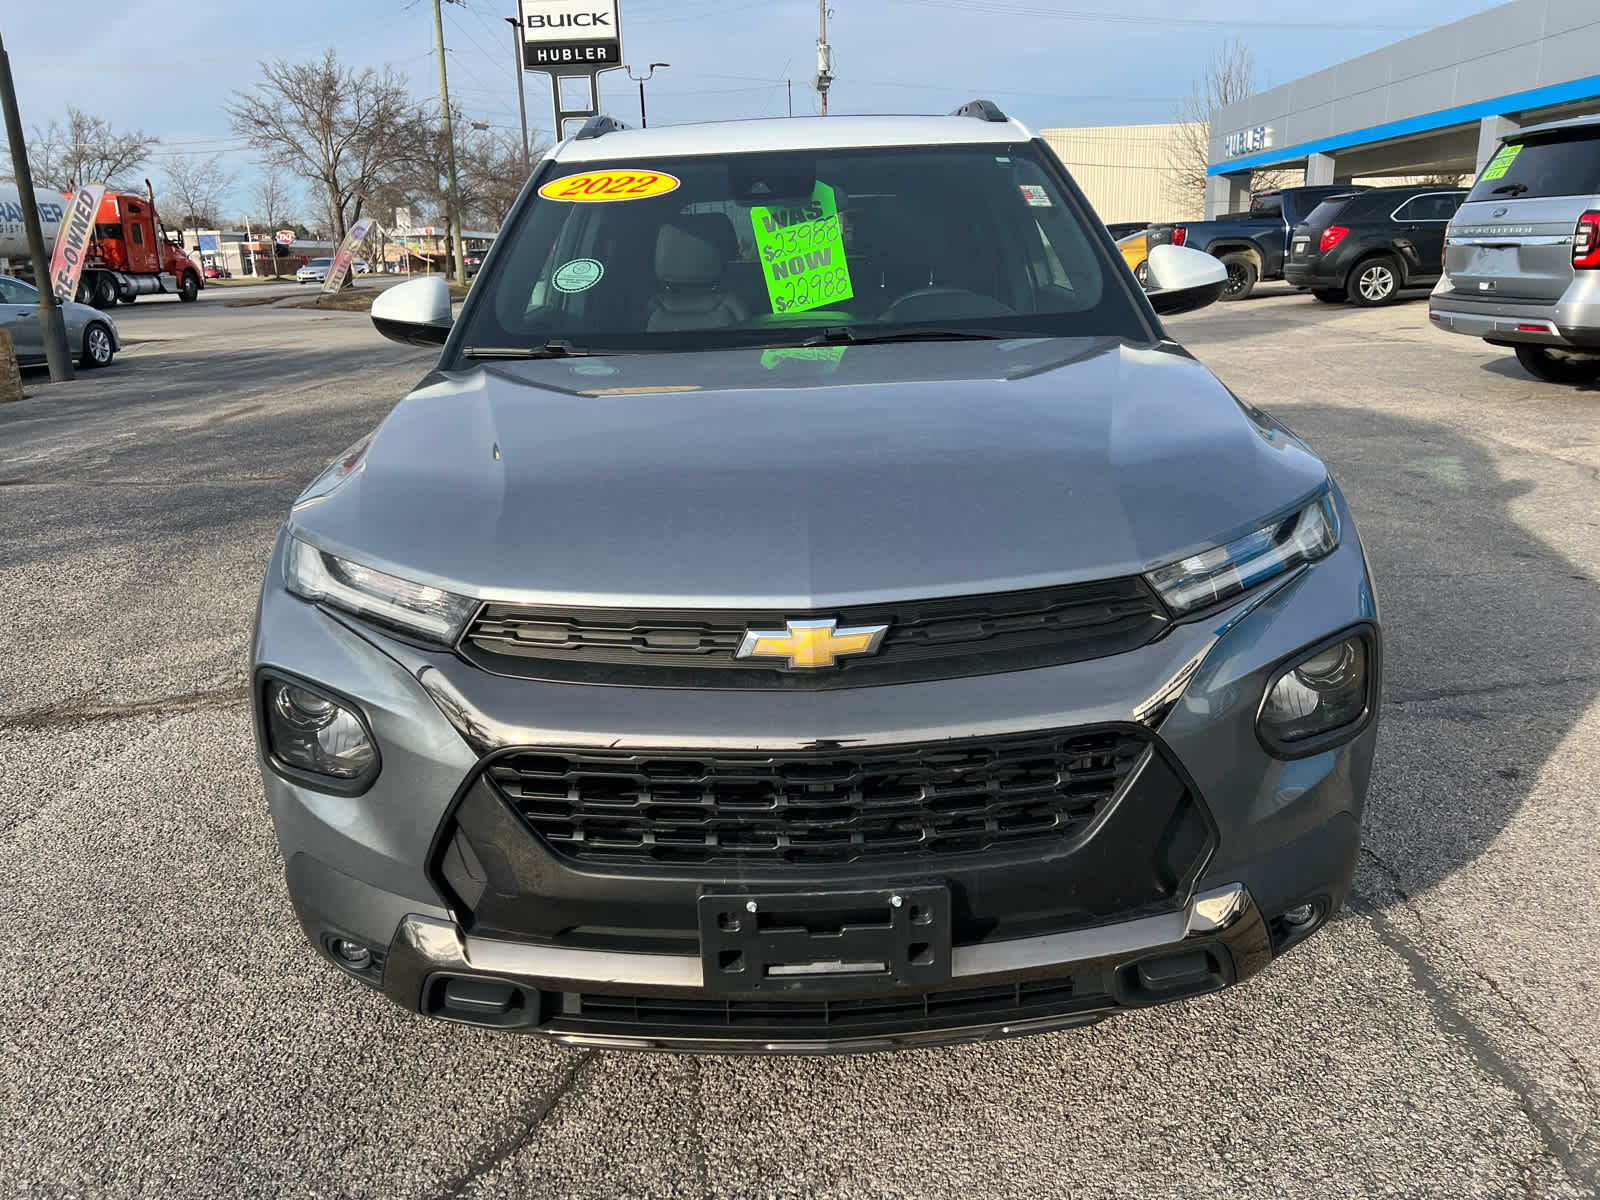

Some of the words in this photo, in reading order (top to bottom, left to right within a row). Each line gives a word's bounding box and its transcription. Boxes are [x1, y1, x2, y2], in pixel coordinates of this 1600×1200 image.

[527, 12, 611, 28] BUICK
[537, 47, 607, 62] HUBLER
[557, 175, 659, 197] 2022
[762, 200, 824, 234] WAS
[771, 246, 832, 281] NOW
[775, 267, 848, 312] $22,988
